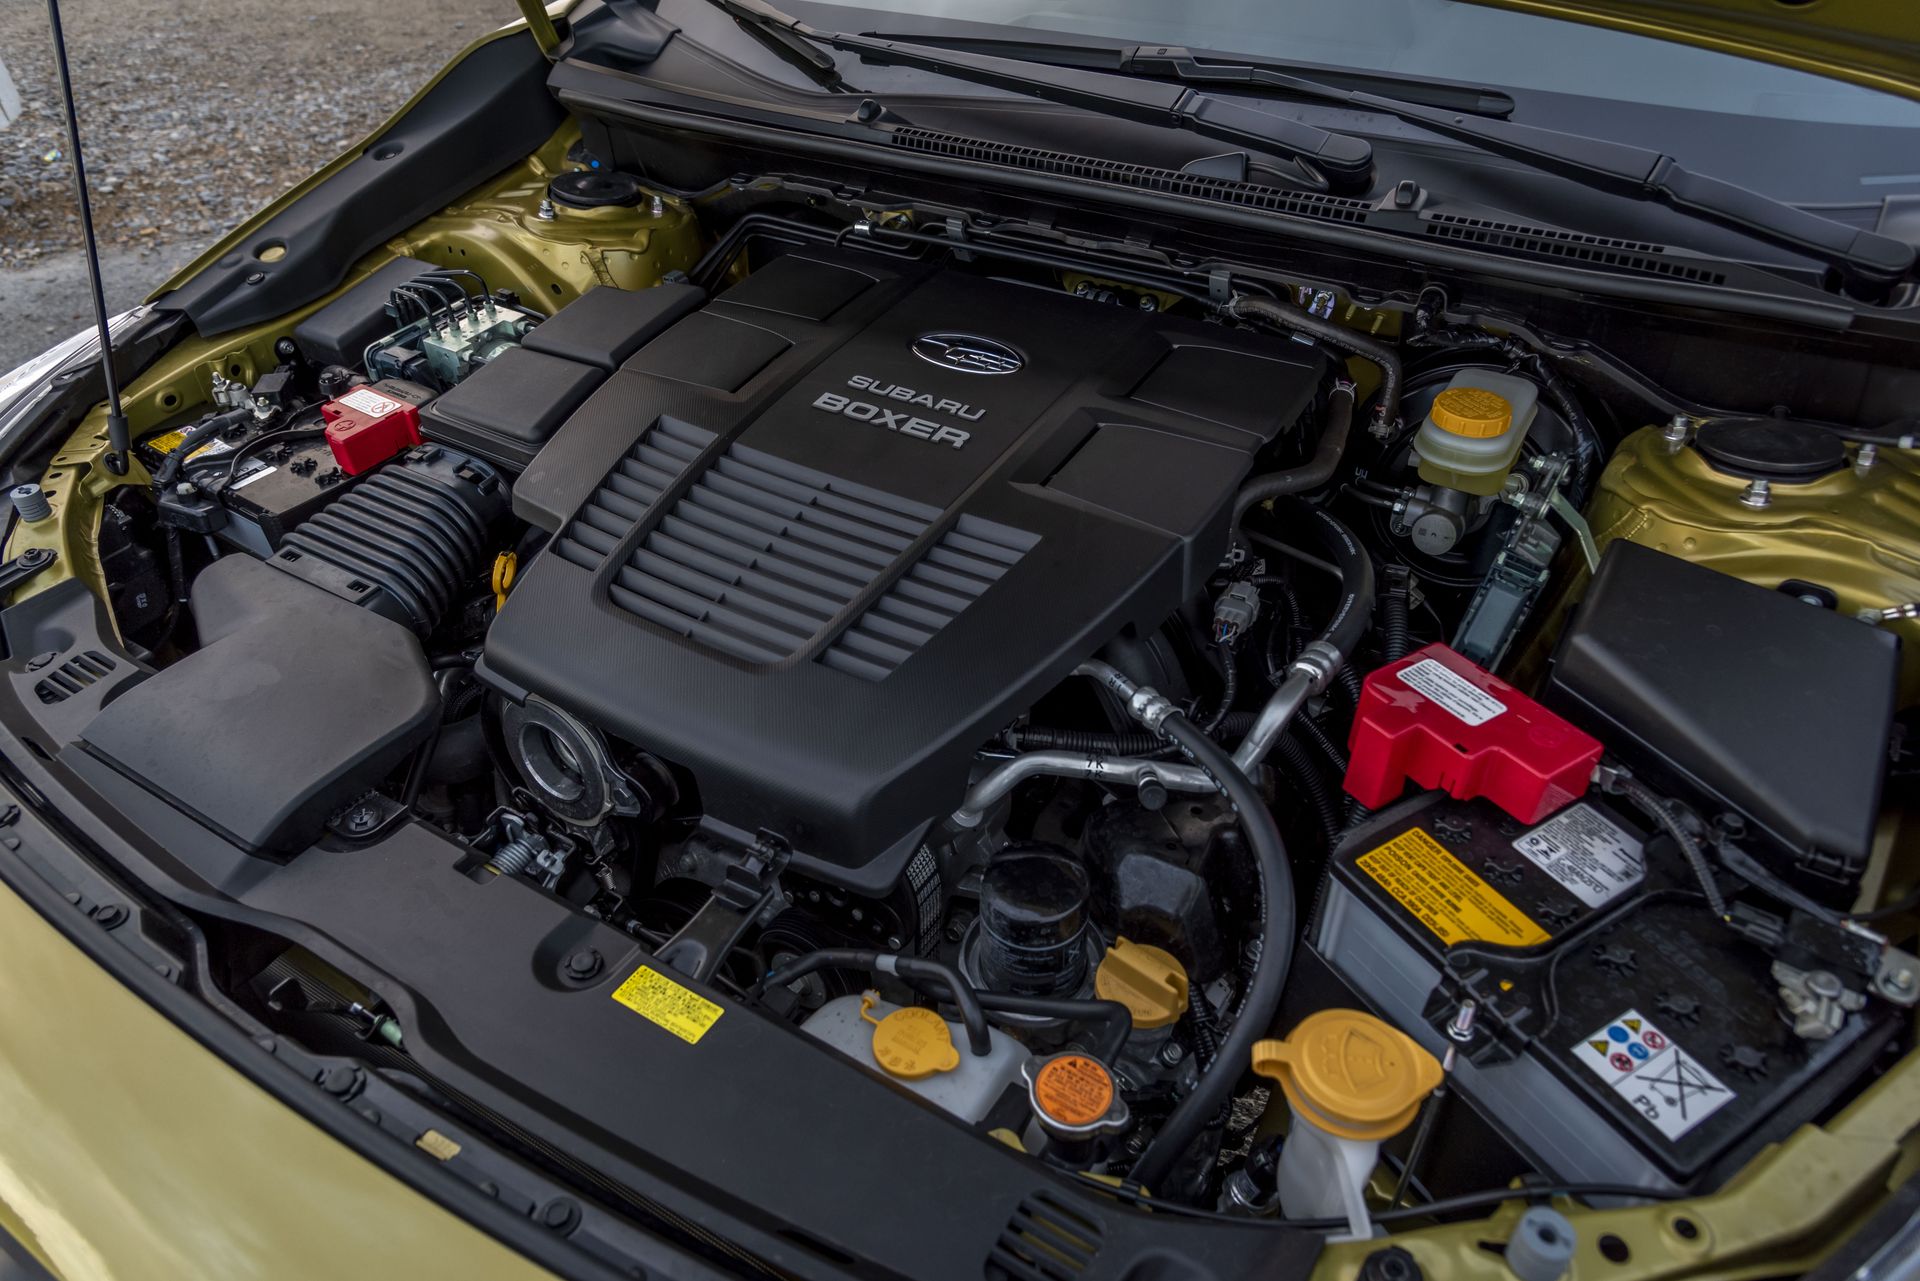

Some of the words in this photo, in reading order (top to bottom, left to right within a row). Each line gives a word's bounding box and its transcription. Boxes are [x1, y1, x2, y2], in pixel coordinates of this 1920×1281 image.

[847, 375, 986, 422] SUBARU
[812, 392, 971, 450] BOXER
[1412, 830, 1442, 854] DANGER
[1383, 846, 1413, 870] POISON
[1632, 1093, 1660, 1120] Pb
